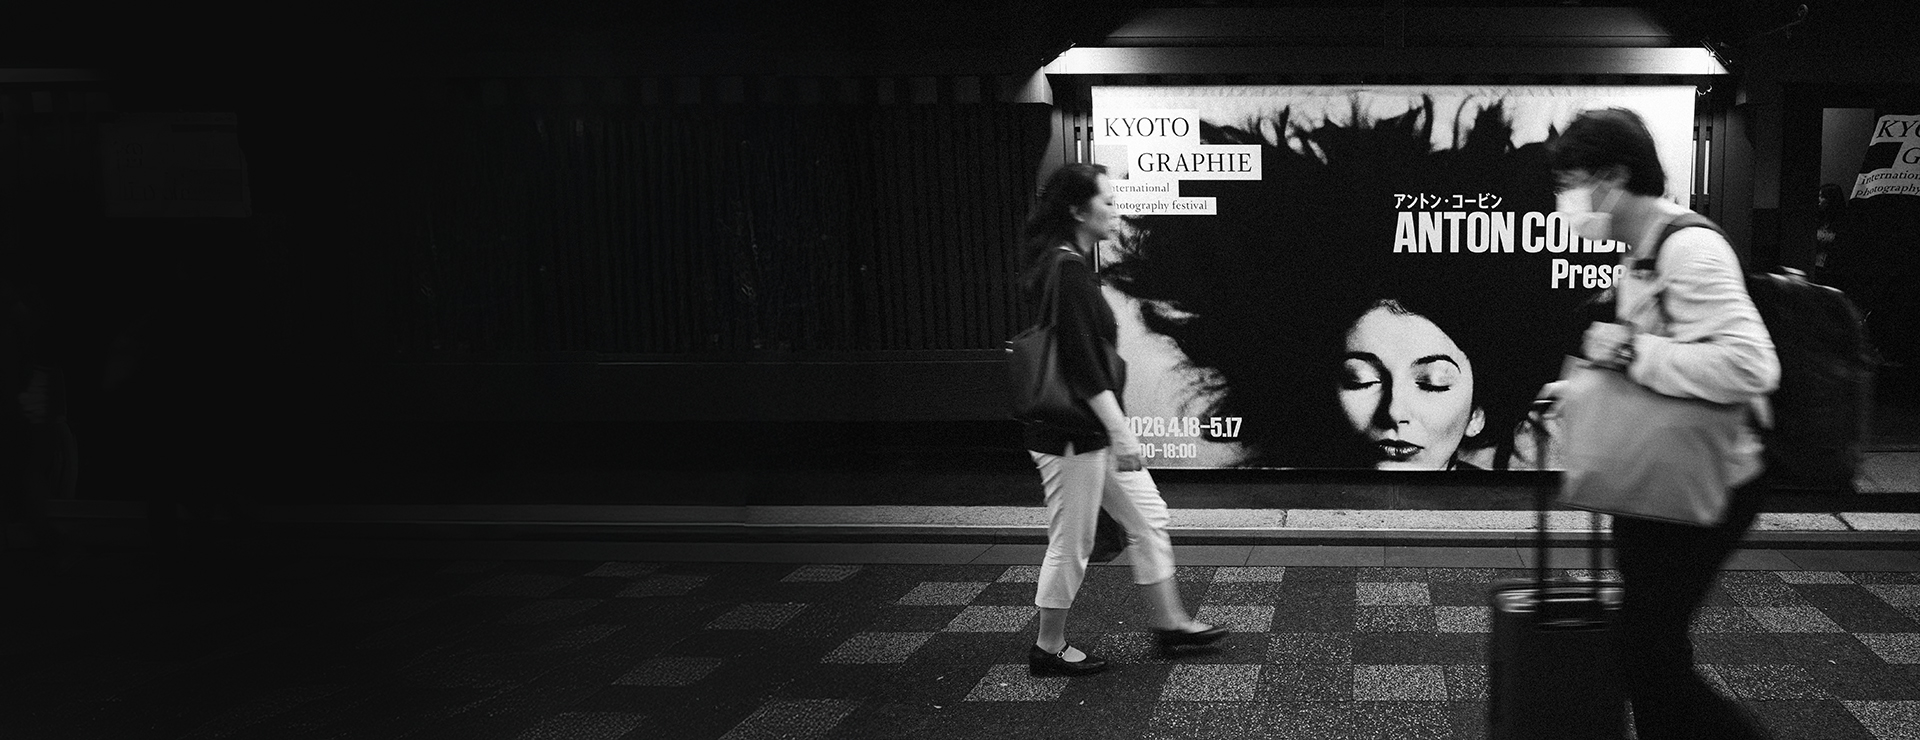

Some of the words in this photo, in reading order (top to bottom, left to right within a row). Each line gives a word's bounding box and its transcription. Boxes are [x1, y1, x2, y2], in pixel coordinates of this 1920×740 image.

[1105, 117, 1190, 138] KYOTO
[1137, 152, 1253, 173] GRAPHIE
[1113, 200, 1169, 212] hotography
[1172, 200, 1208, 210] festival
[1394, 193, 1502, 209] アントン・コービン
[1393, 211, 1515, 253] ANTON
[1551, 258, 1627, 289] Prese
